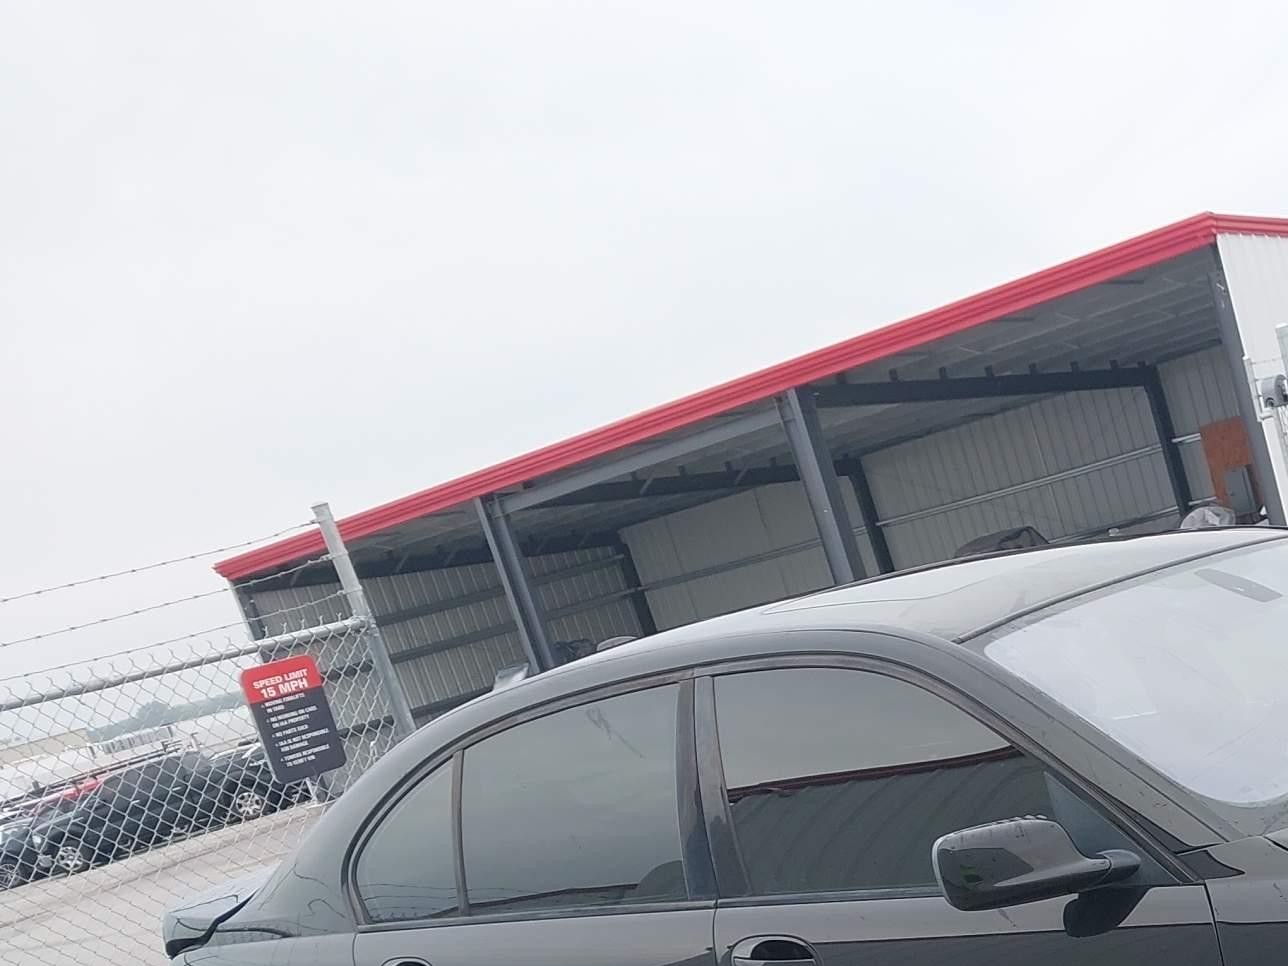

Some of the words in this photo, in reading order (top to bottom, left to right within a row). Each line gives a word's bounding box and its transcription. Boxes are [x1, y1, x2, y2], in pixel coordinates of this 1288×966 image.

[253, 675, 283, 689] SPEED
[283, 669, 307, 681] LIMIT
[260, 686, 276, 699] 15
[278, 677, 308, 694] MPH
